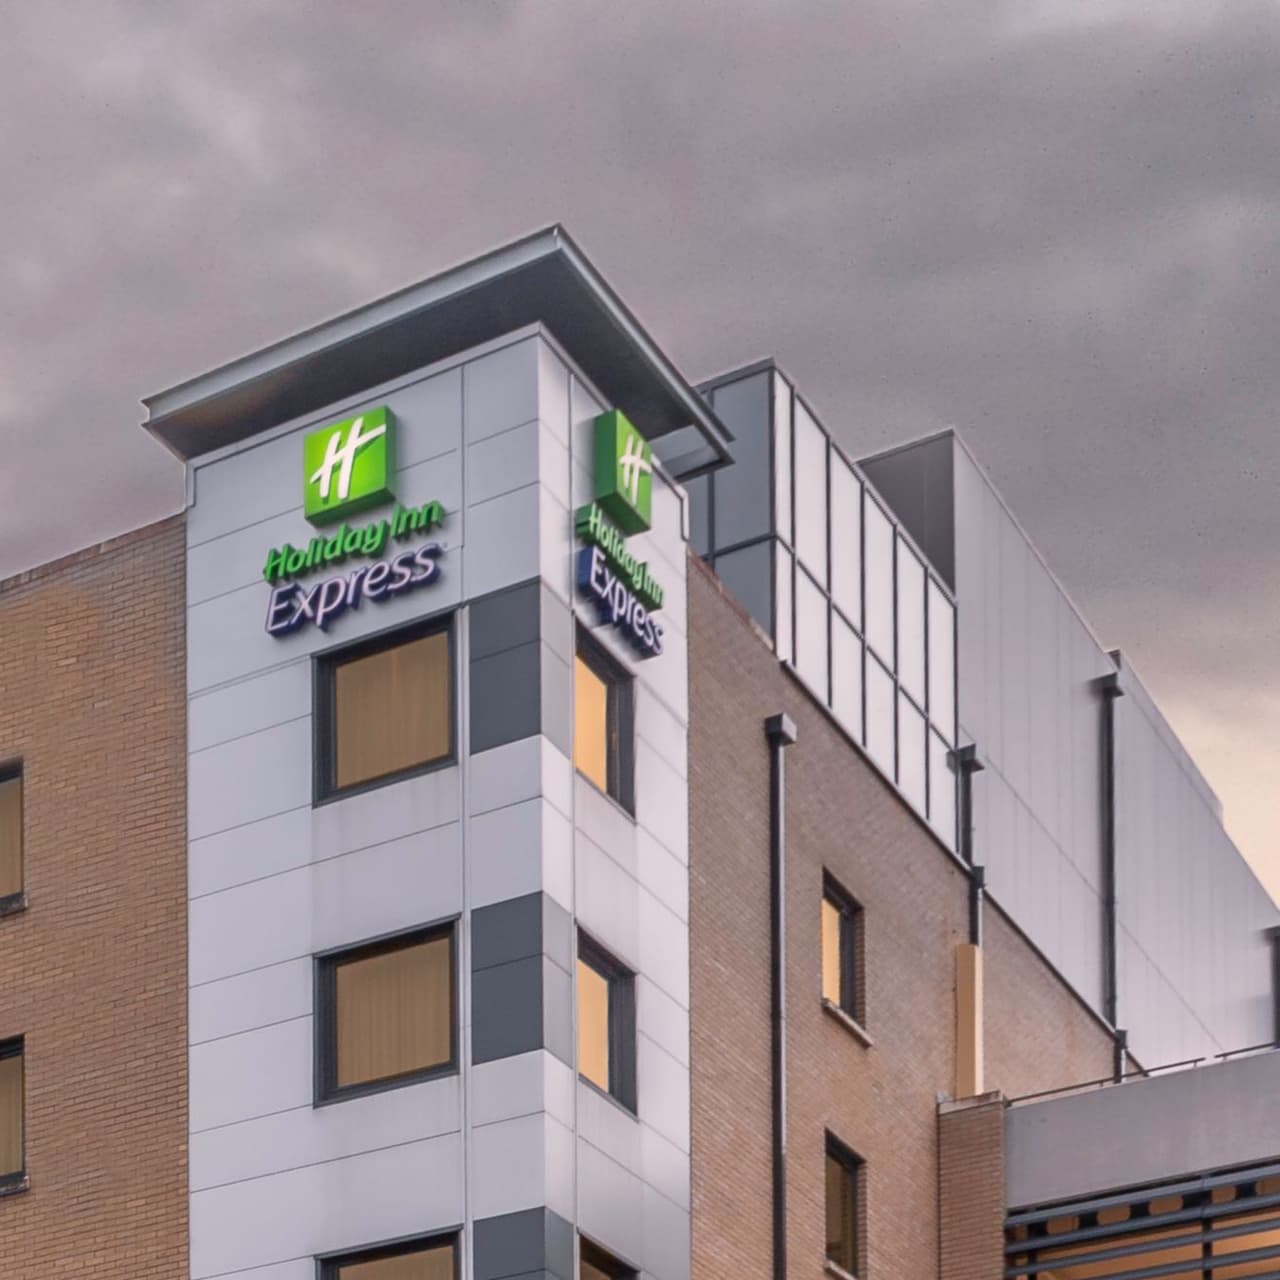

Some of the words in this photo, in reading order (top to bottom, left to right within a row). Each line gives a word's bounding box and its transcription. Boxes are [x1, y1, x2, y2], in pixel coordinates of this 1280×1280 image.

[310, 416, 387, 500] H
[264, 522, 390, 583] Holiday
[389, 501, 444, 541] Inn
[588, 502, 642, 592] Holiday
[640, 561, 665, 607] Inn
[266, 543, 443, 637] Express
[589, 545, 665, 656] Express
